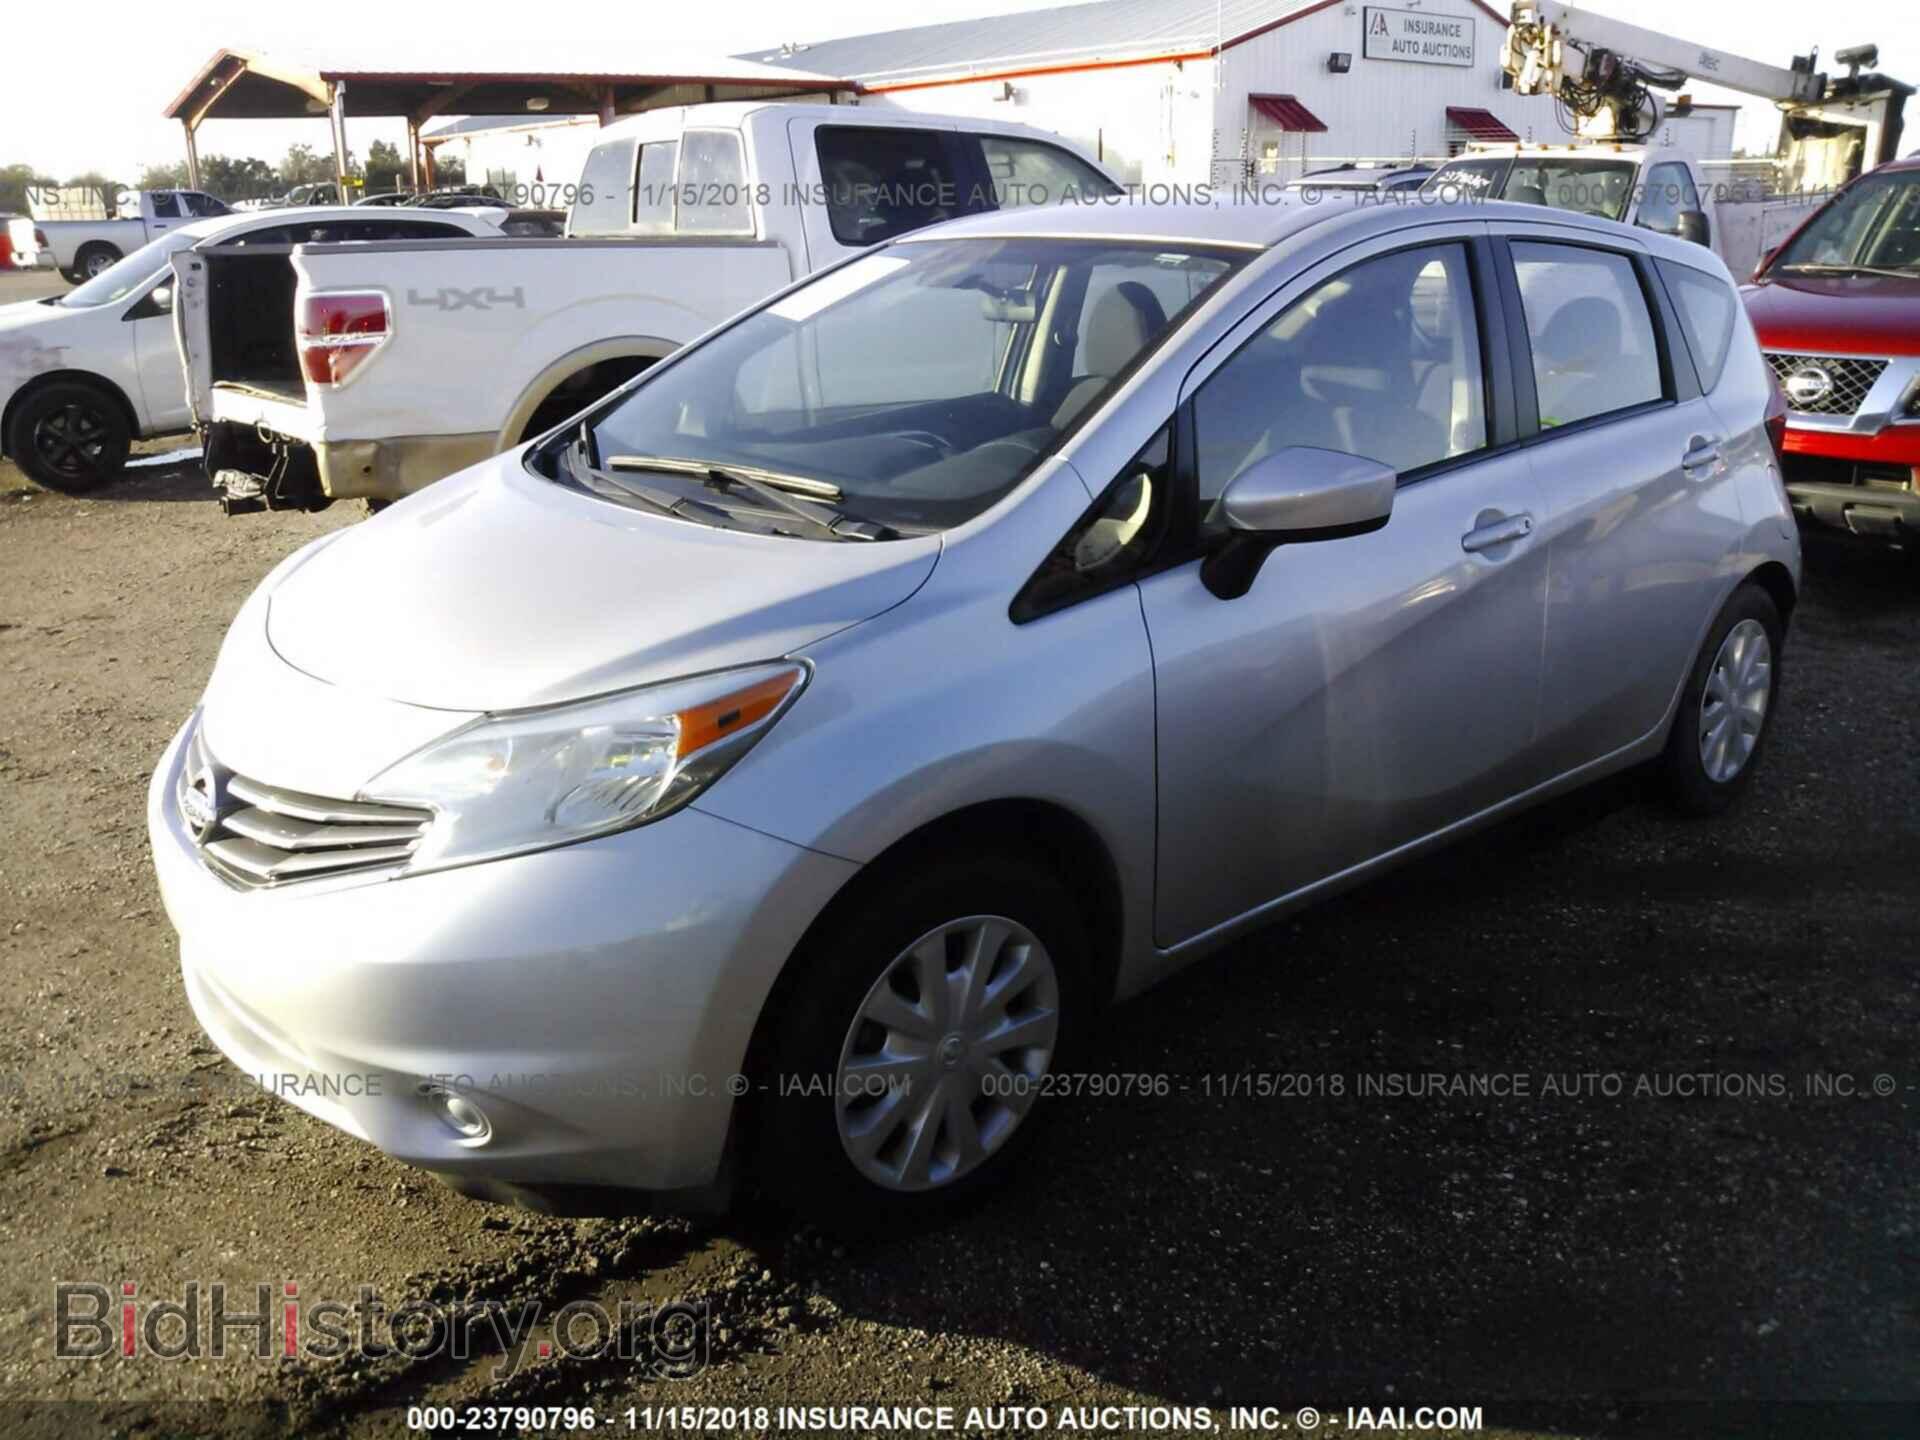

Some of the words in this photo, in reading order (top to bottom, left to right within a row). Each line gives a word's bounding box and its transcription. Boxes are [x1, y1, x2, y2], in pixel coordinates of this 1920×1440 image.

[1403, 19, 1462, 38] INSURANCE
[1392, 40, 1420, 54] AUTO
[1422, 42, 1472, 59] AUCTIONS
